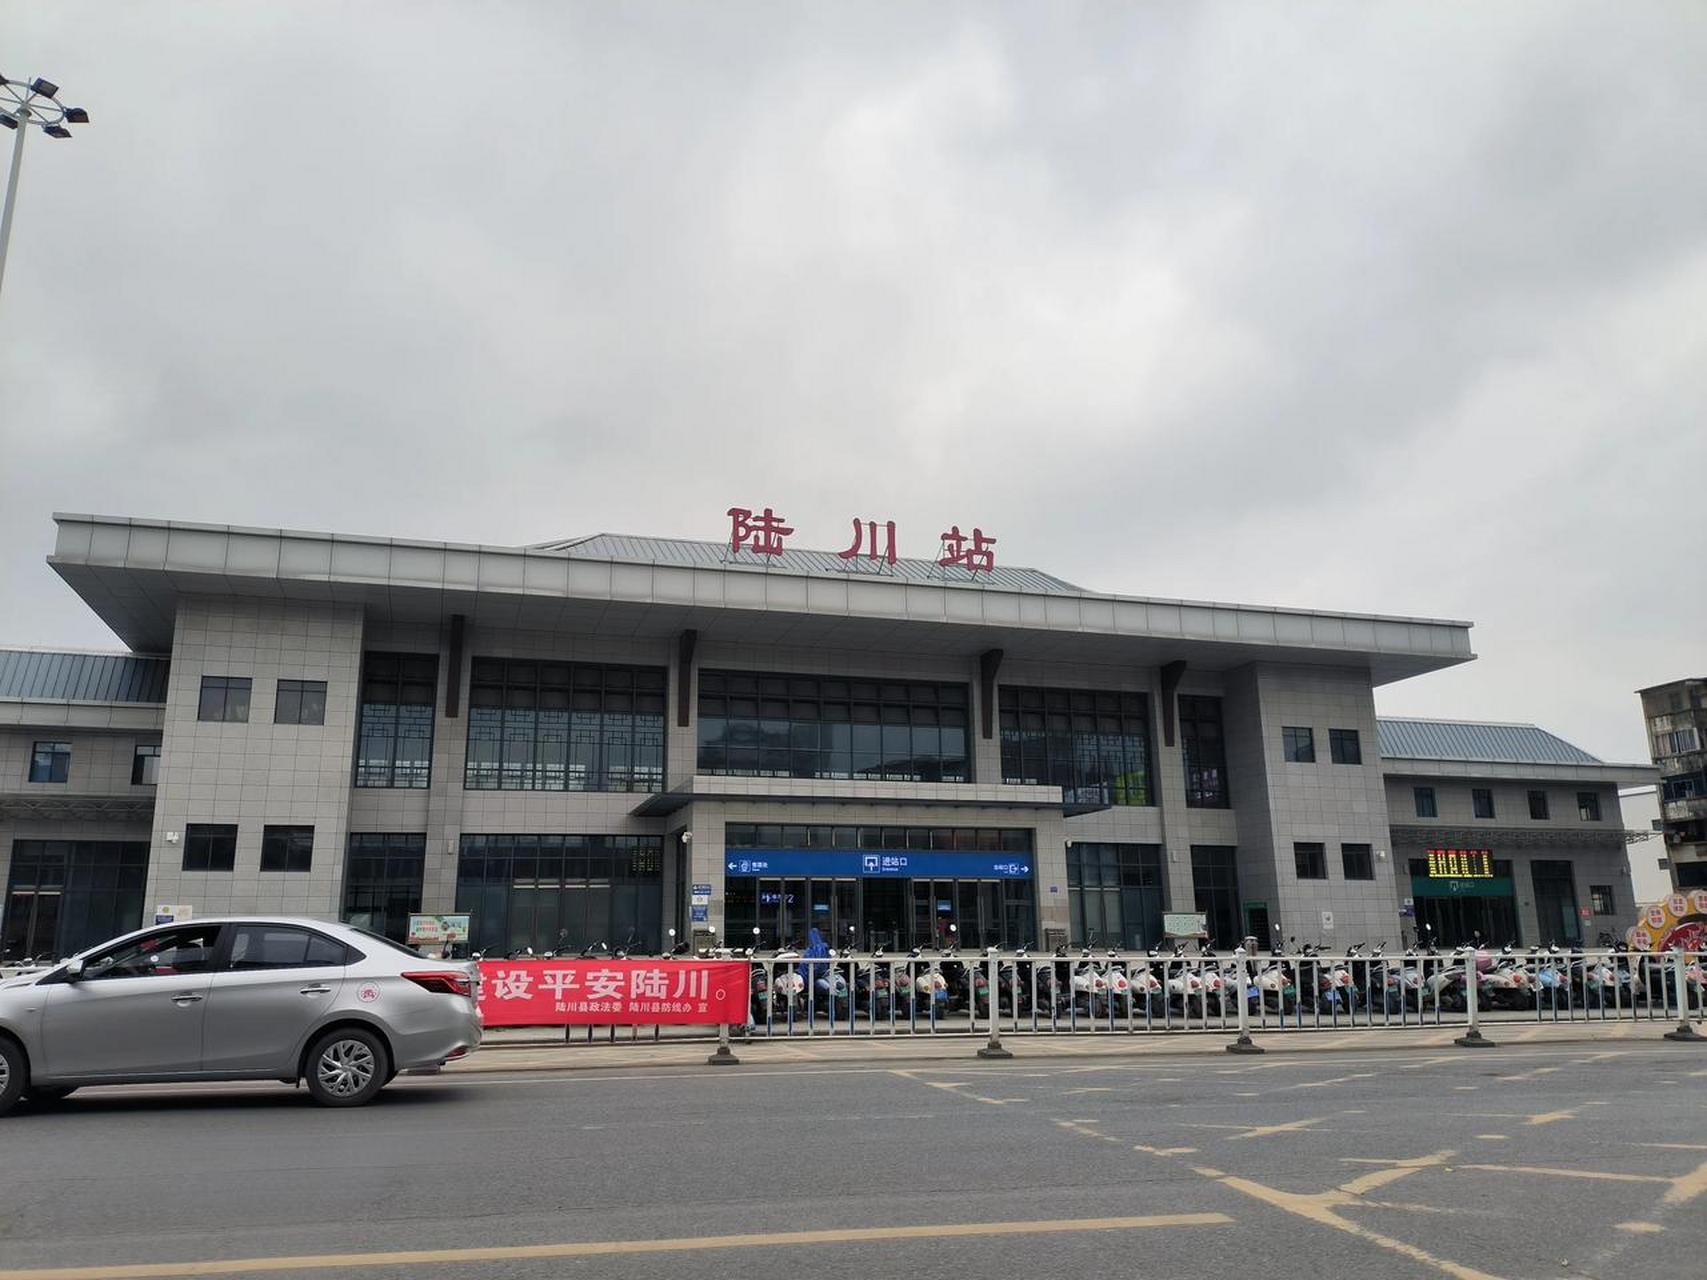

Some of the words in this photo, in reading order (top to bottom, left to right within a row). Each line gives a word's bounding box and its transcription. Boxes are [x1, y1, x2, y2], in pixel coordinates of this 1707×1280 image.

[727, 507, 997, 573] 陆川站
[881, 856, 908, 867] 进站口
[555, 1001, 622, 1013] 陆川县政法委
